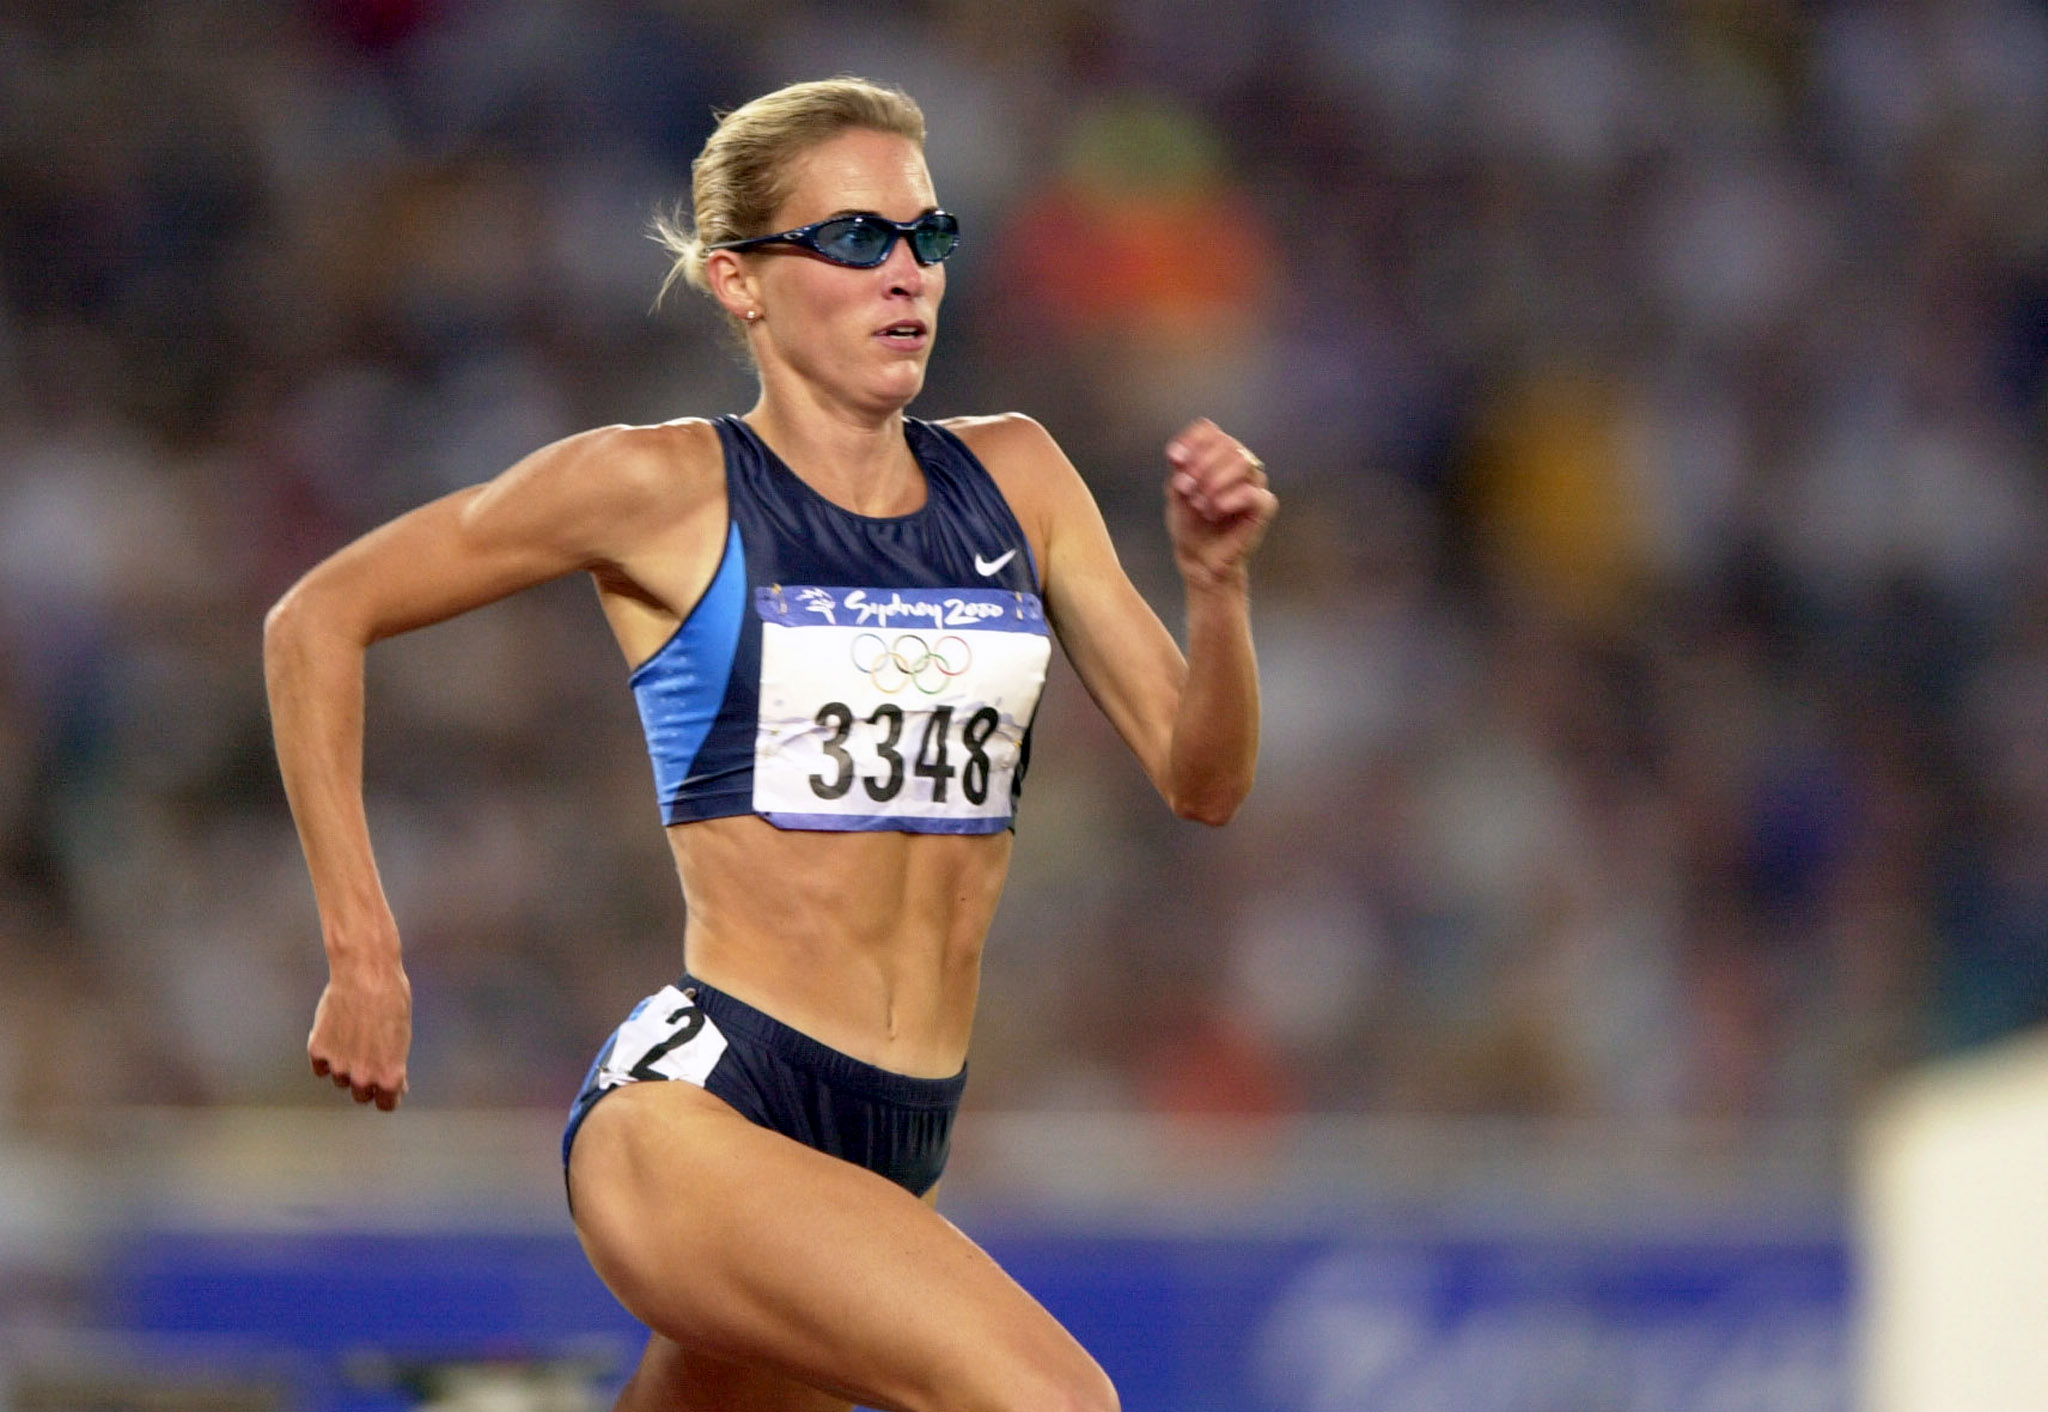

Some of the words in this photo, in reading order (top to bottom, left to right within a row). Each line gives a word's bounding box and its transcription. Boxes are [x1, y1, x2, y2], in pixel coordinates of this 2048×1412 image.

[844, 590, 943, 629] Sydney
[944, 599, 1003, 625] 2000
[809, 702, 999, 805] 3348
[629, 1006, 705, 1081] 2
